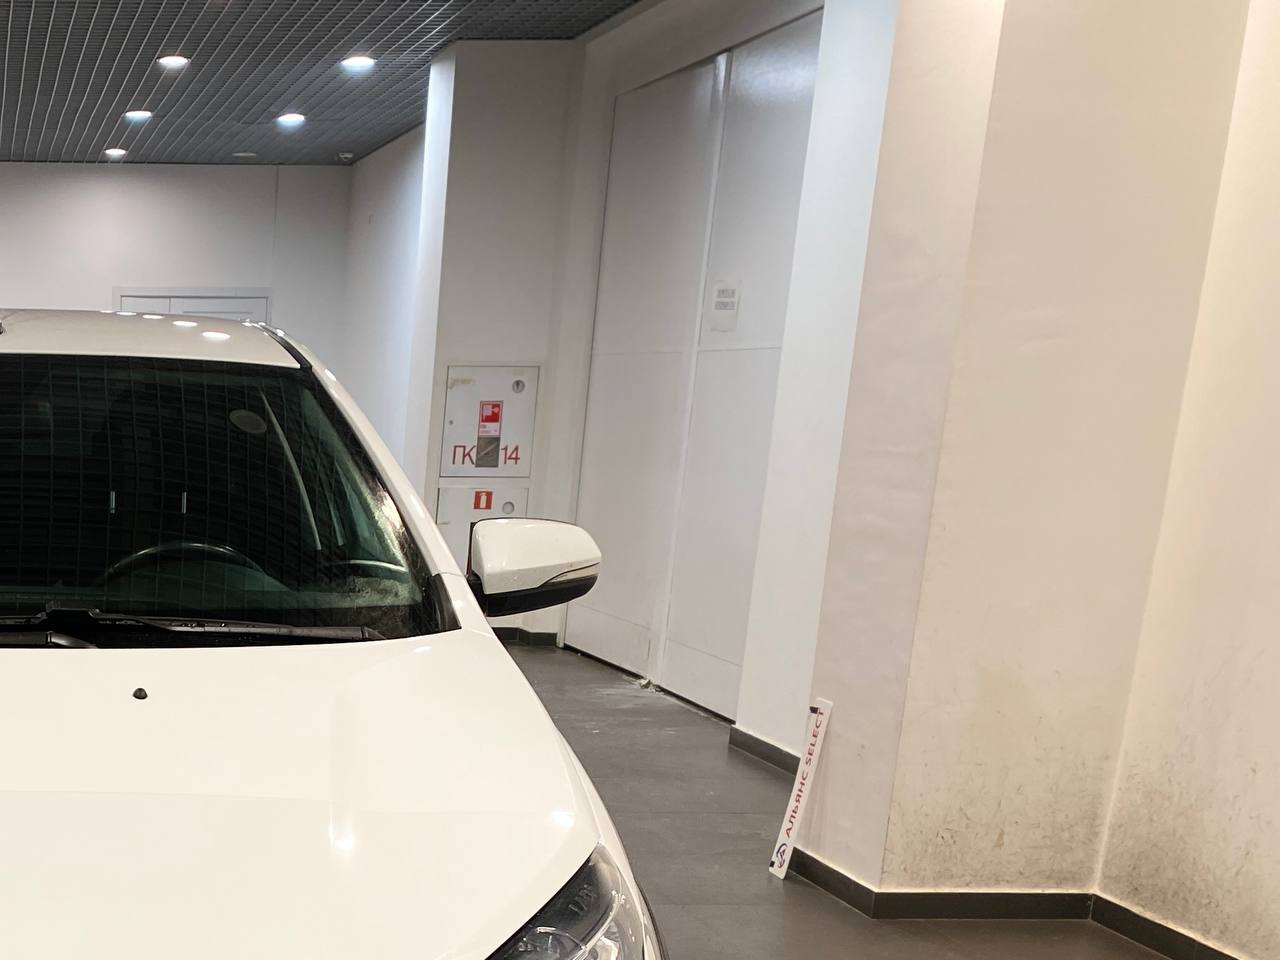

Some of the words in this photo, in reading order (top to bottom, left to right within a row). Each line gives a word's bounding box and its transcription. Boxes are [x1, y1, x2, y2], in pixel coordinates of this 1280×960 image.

[452, 445, 477, 465] ПК
[501, 445, 520, 465] 14
[785, 771, 809, 838] АЛЬЯНС
[805, 711, 824, 766] SELECT
